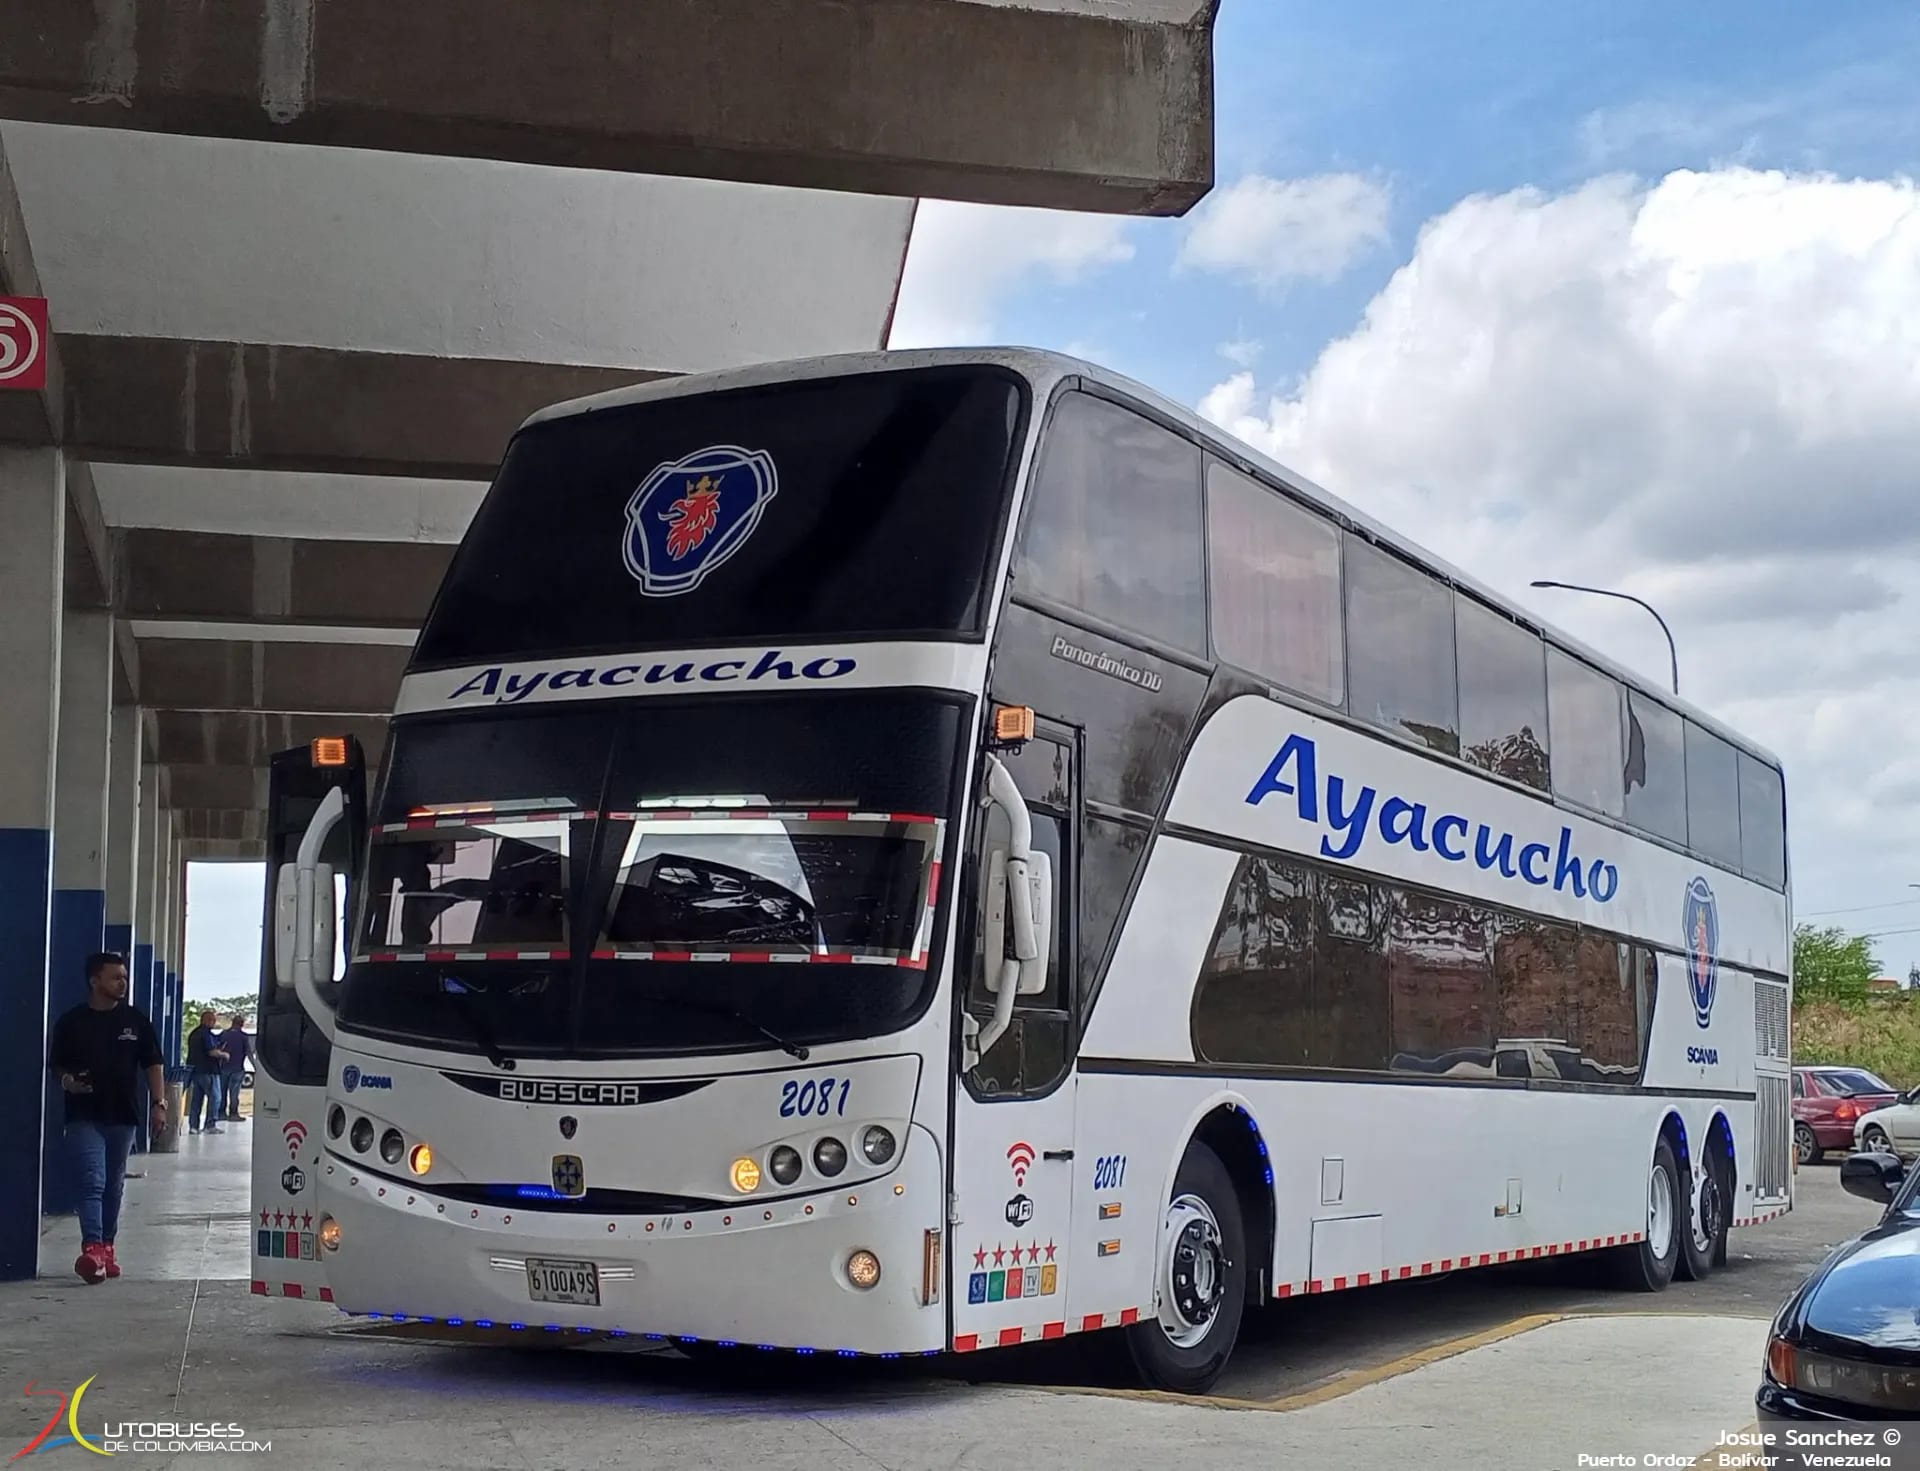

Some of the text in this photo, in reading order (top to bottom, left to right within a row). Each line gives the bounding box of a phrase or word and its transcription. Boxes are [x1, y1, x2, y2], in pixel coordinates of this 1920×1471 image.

[447, 650, 857, 704] Ayacucho
[1141, 671, 1162, 691] DD
[1245, 733, 1618, 903] Ayacucho
[1687, 1046, 1718, 1065] SCANIA
[500, 1081, 639, 1104] BUSSCAR
[780, 1078, 850, 1117] 2081
[1094, 1155, 1127, 1190] 2081
[1026, 1275, 1038, 1287] TV
